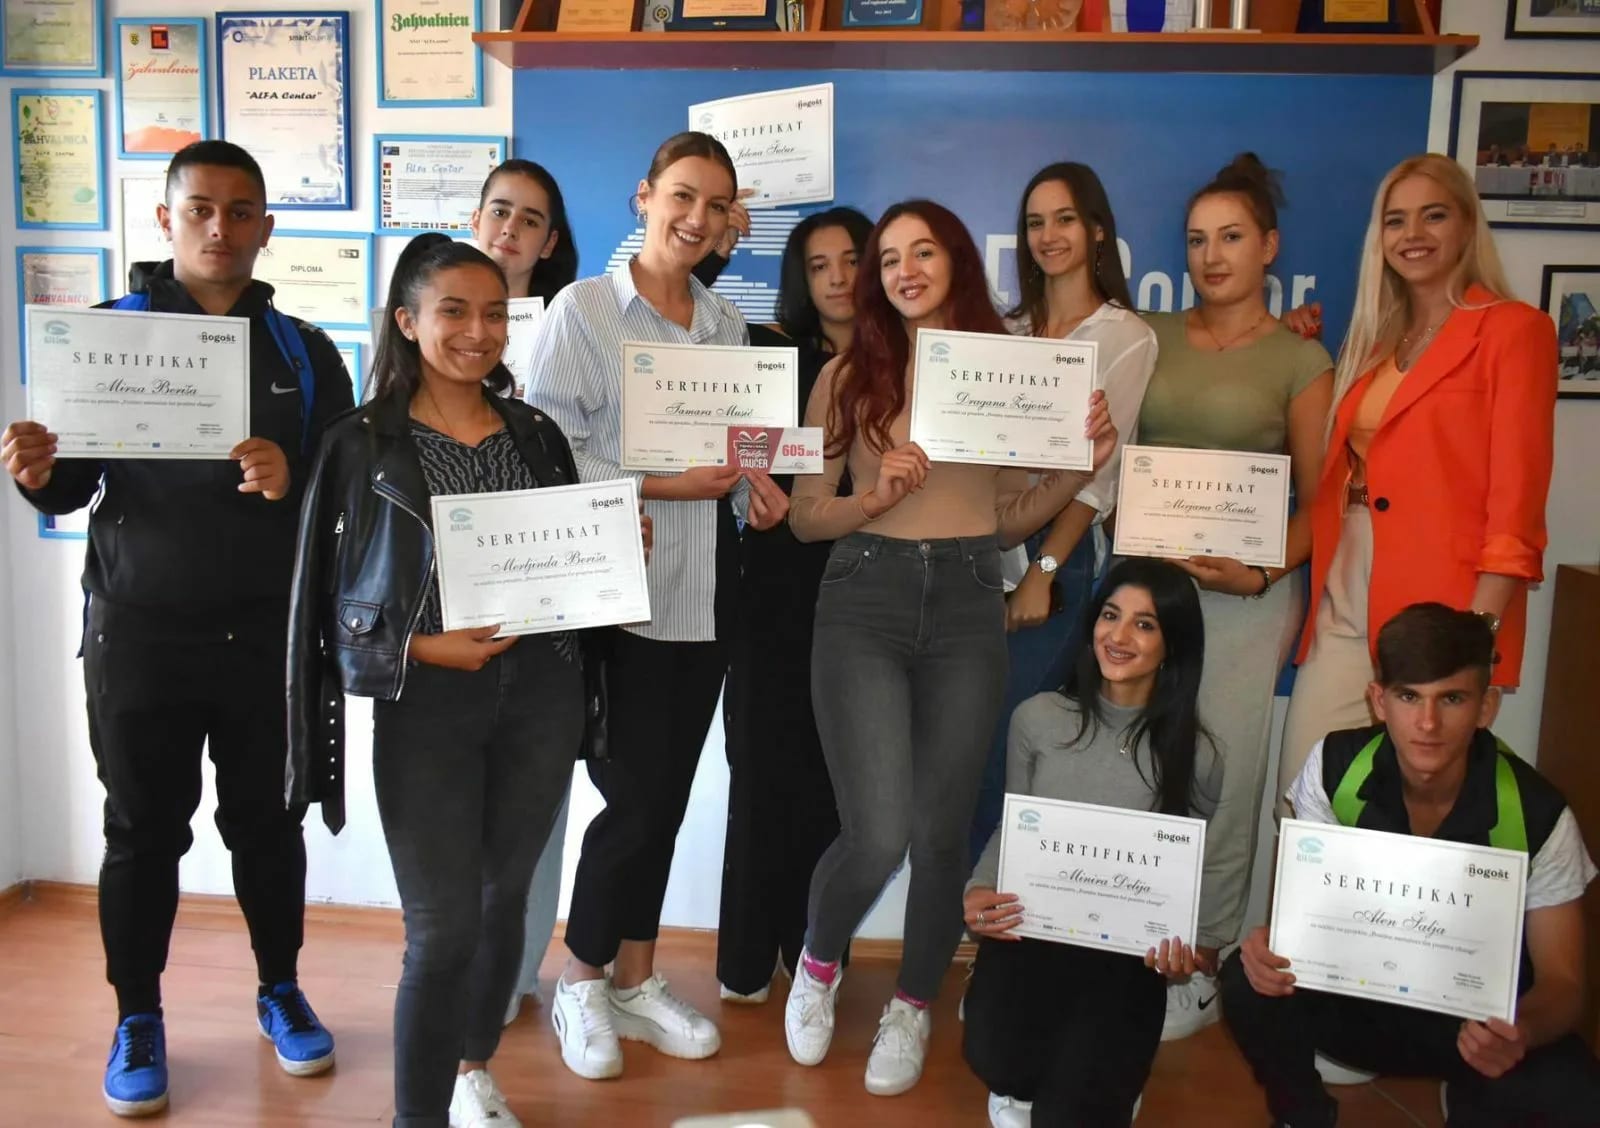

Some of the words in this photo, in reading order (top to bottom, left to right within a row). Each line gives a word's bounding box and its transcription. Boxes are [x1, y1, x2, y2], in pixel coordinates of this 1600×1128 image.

[248, 66, 318, 80] PLAKETA
[290, 264, 324, 273] DIPLOMA
[72, 351, 209, 370] SERTIFIKAT
[95, 376, 146, 395] Mirza
[655, 379, 764, 395] SERTIFIKAT
[950, 368, 1062, 388] SERTIFIKAT
[665, 400, 712, 417] Tamara
[954, 391, 1007, 410] Dragana
[1151, 477, 1256, 495] SERTIFIKAT
[476, 523, 601, 549] SERTIFIKAT
[1039, 838, 1163, 868] SERTIFIKAT
[1322, 871, 1475, 908] SERTIFIKAT
[1352, 907, 1399, 928] Alen
